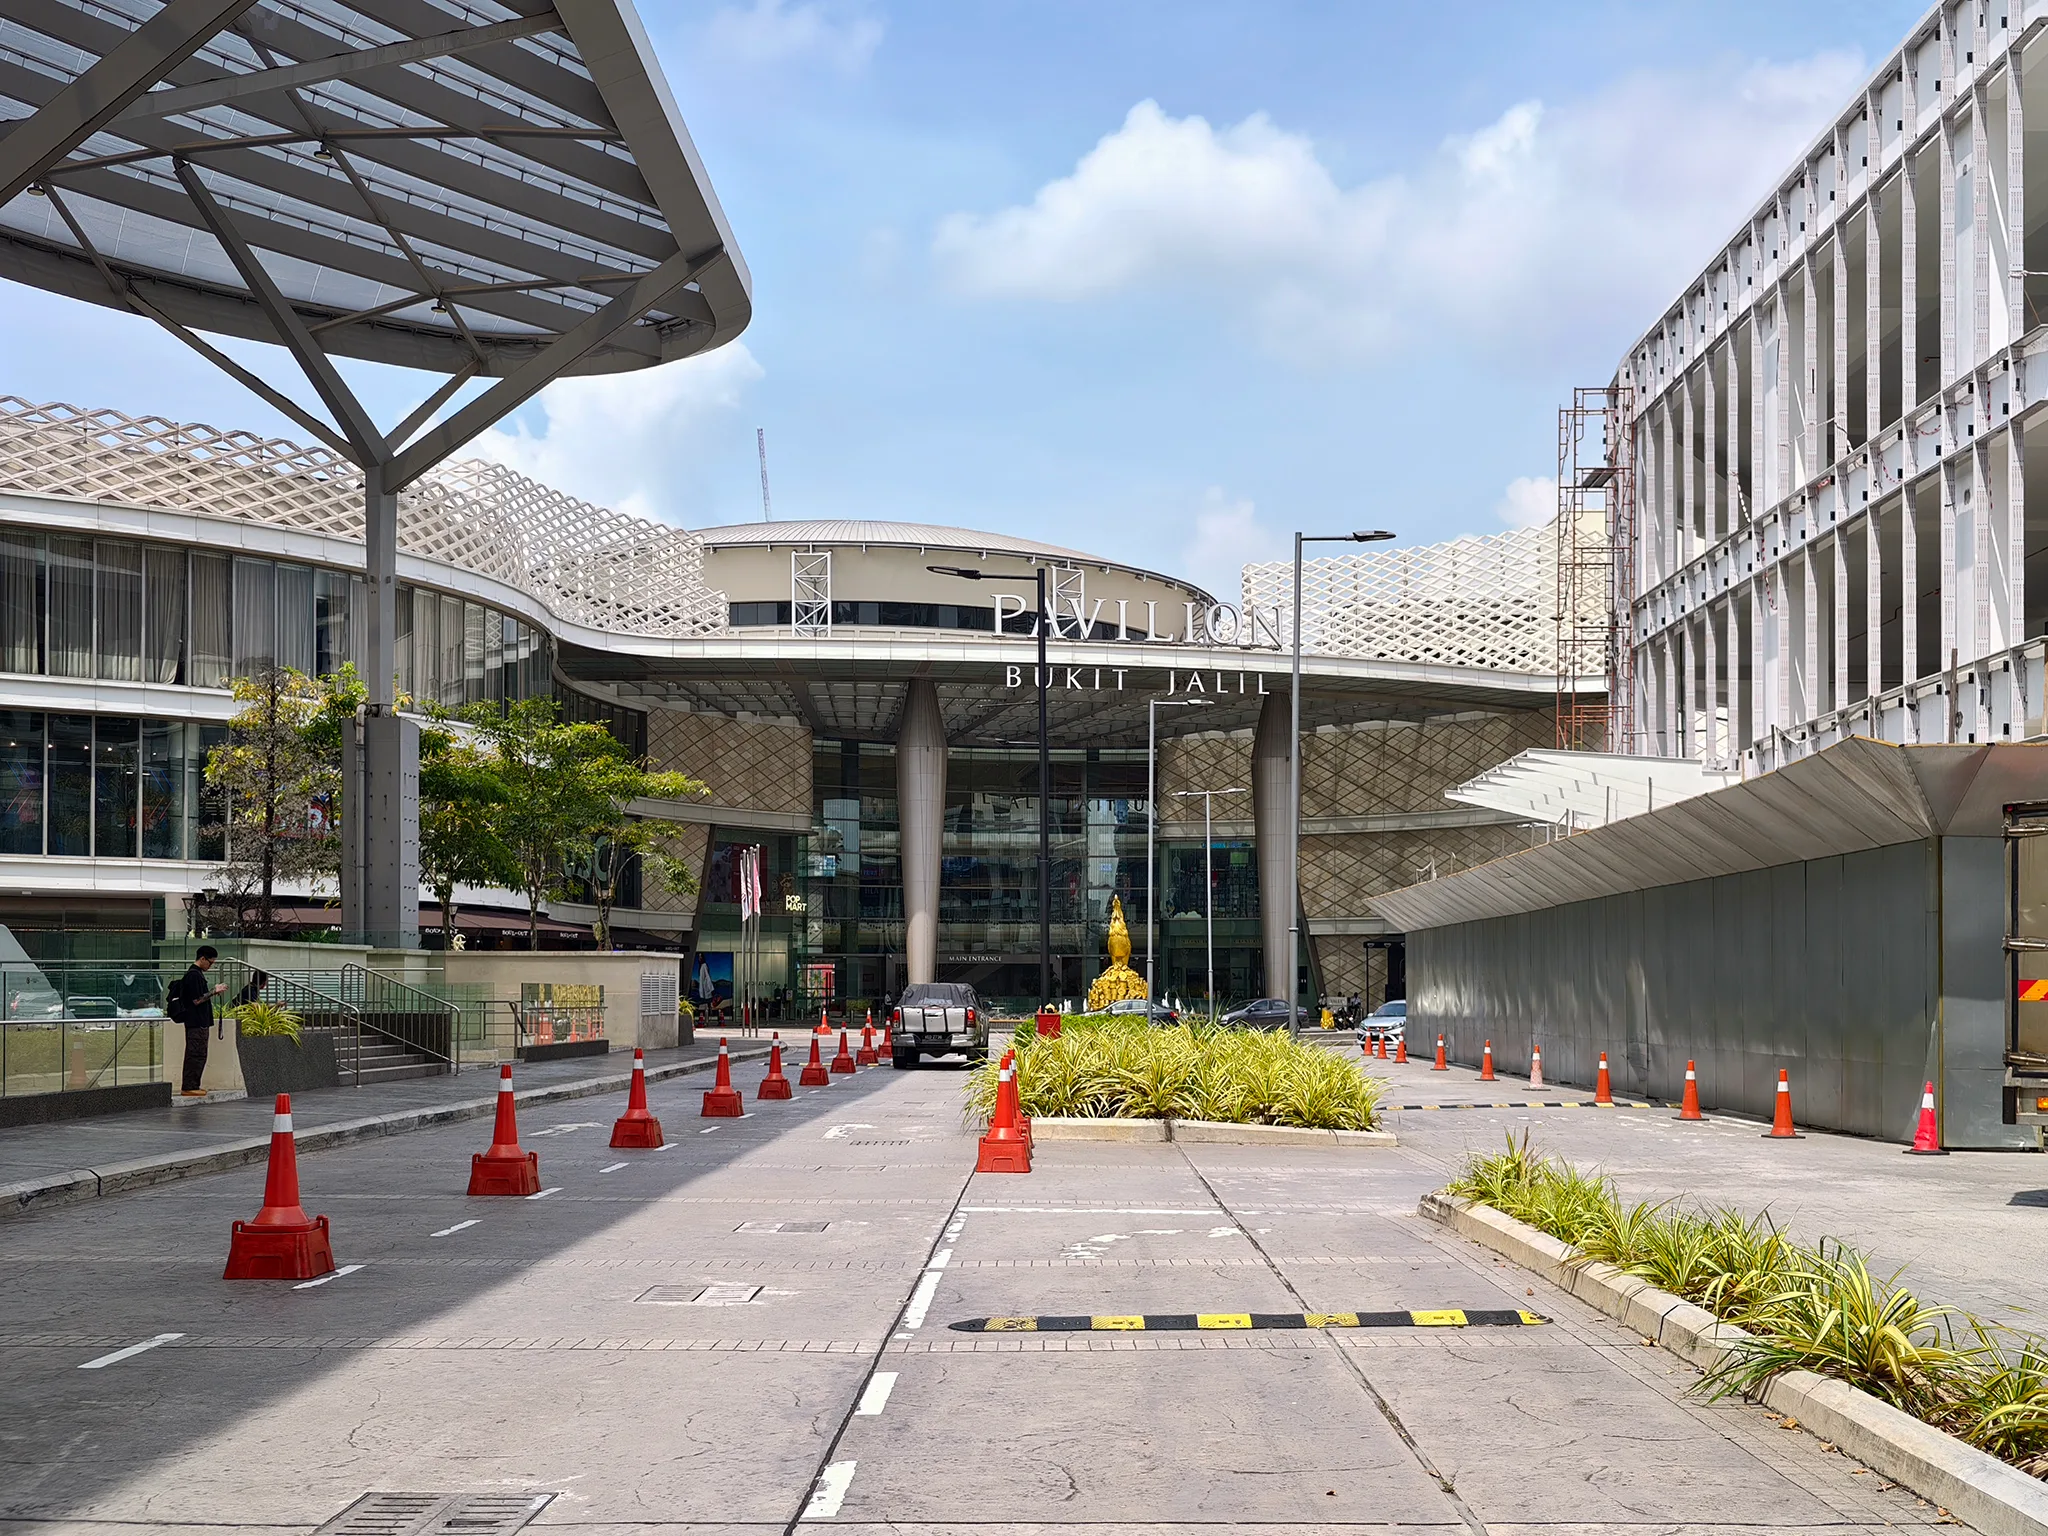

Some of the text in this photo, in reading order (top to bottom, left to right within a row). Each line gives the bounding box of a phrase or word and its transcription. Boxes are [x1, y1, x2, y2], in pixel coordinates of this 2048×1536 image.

[990, 594, 1285, 651] PAVILION
[1006, 666, 1270, 696] BUKIT JALIL
[785, 895, 801, 903] POP
[785, 902, 807, 911] MART
